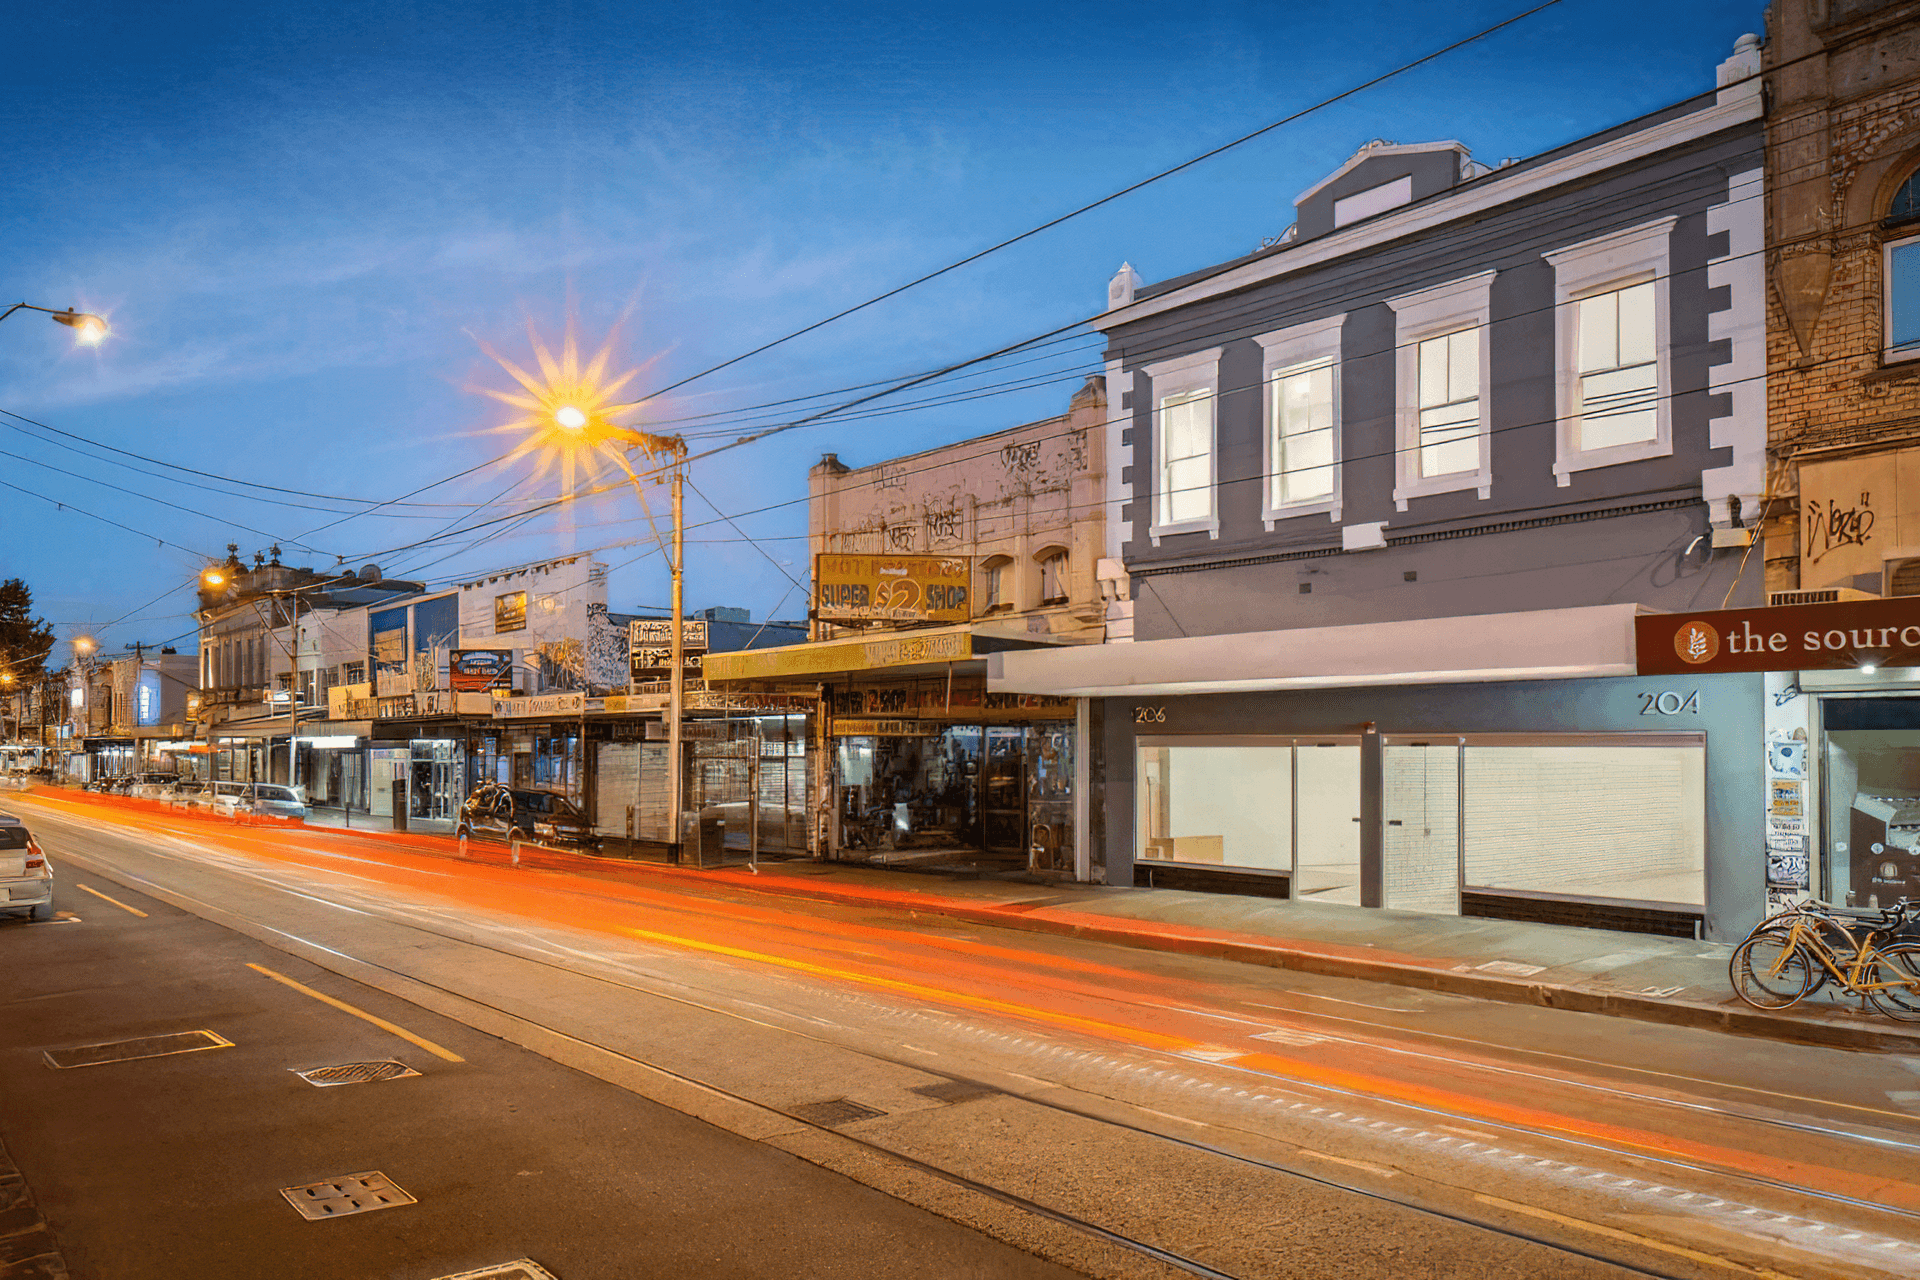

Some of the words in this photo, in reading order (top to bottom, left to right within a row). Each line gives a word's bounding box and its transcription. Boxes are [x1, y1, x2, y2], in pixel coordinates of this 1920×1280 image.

[1726, 620, 1788, 653] the
[1803, 625, 1920, 651] sourc
[1135, 706, 1166, 723] 206
[1637, 689, 1700, 716] 204
